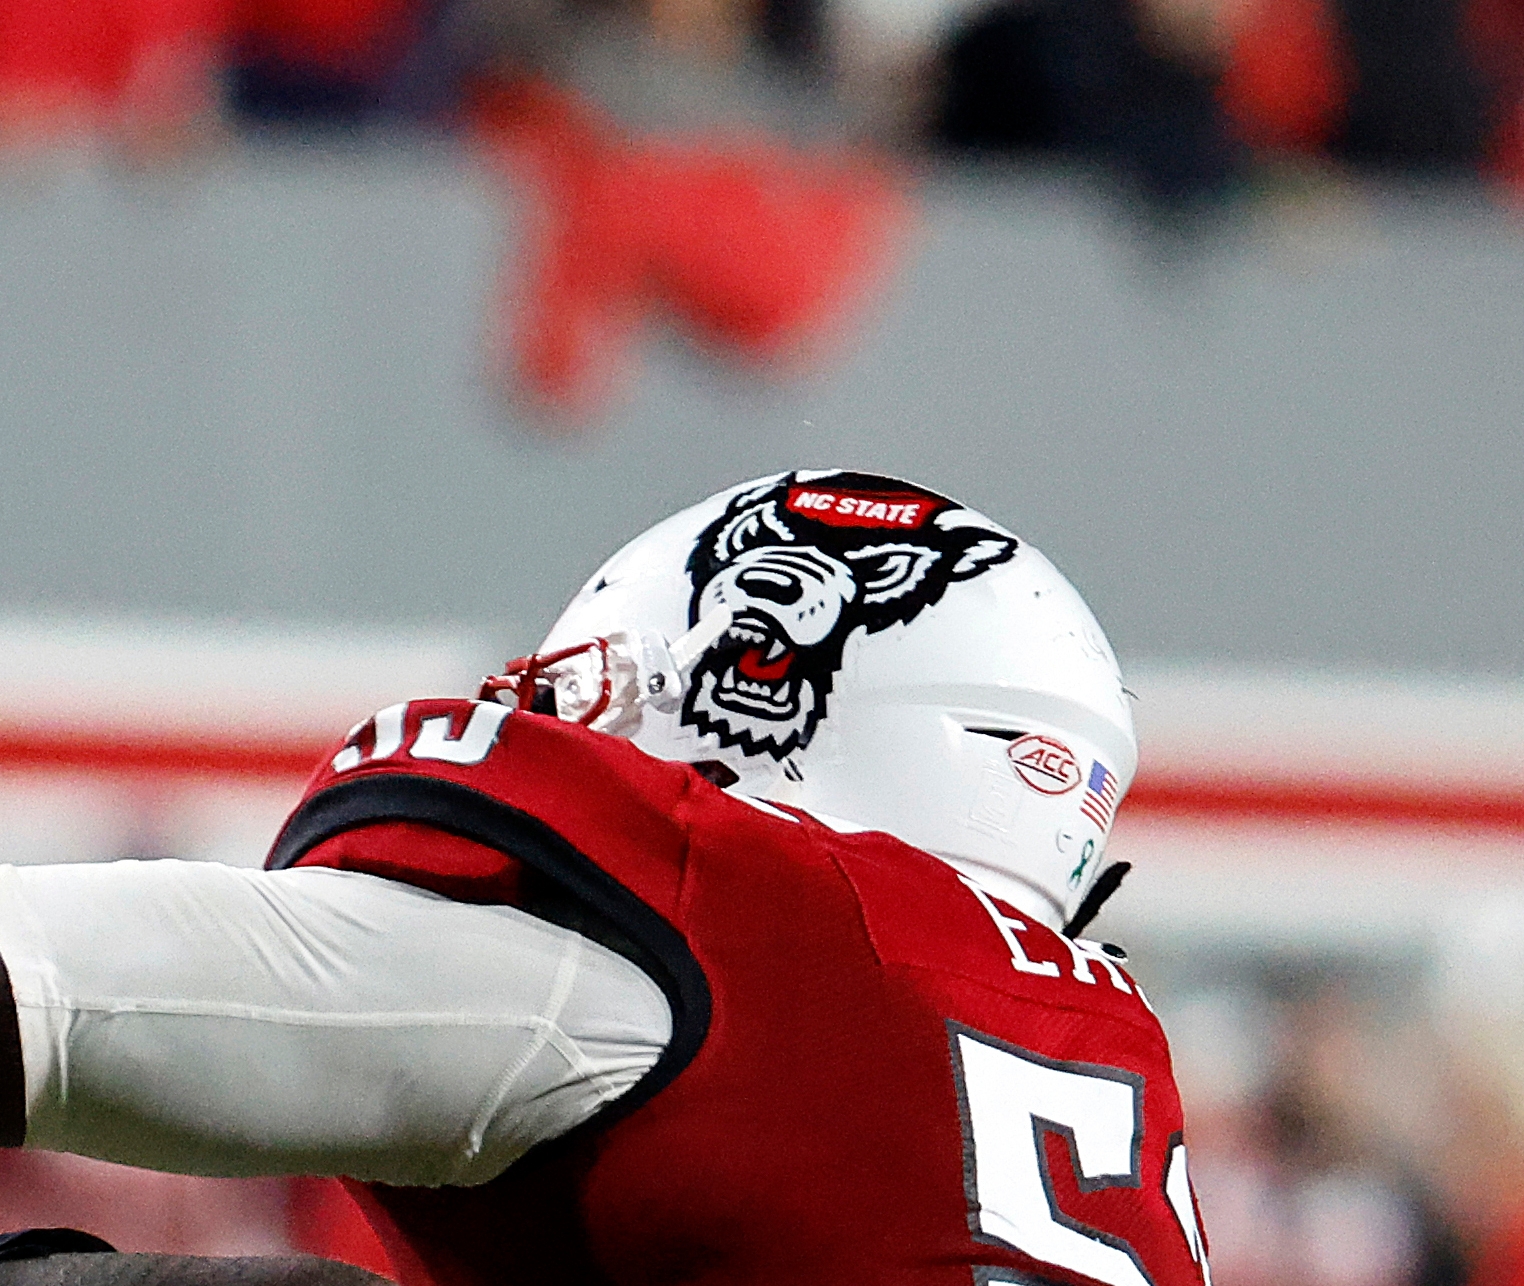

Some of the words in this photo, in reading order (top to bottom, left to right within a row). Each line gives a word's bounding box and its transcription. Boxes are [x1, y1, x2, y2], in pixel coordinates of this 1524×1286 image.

[793, 492, 836, 511] NC
[835, 497, 921, 525] STATE
[1020, 748, 1075, 779] ACC
